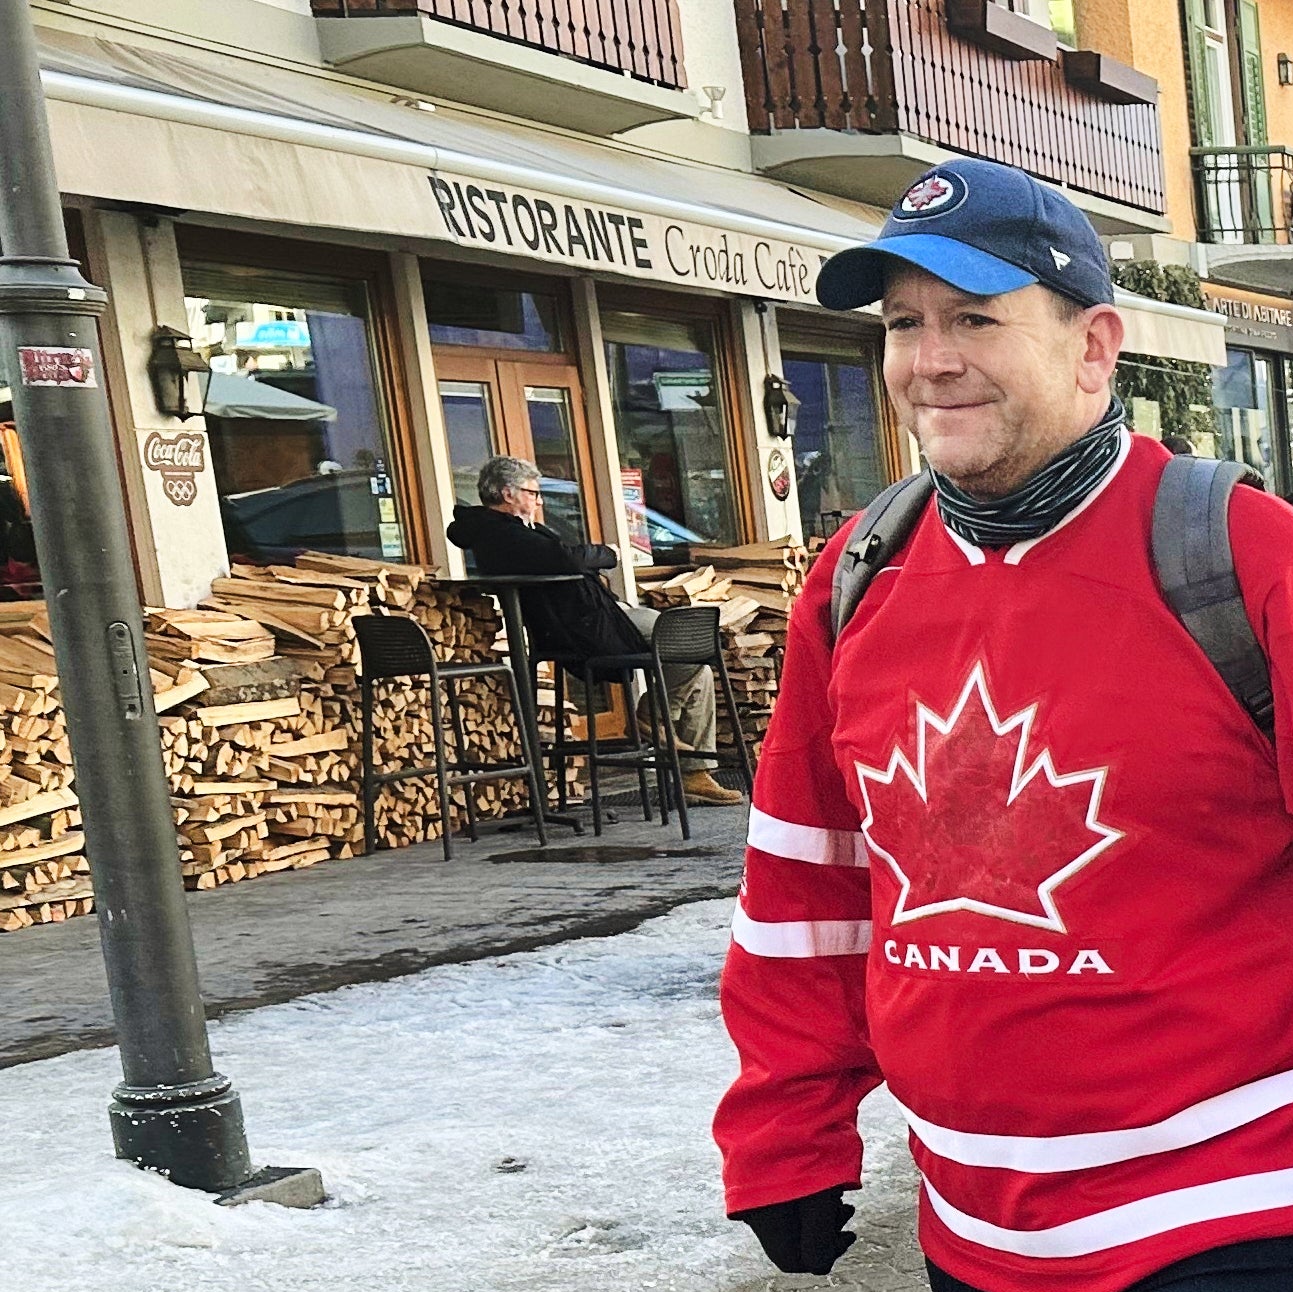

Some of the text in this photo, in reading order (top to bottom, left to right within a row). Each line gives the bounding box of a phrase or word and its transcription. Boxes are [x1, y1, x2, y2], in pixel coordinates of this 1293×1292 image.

[427, 176, 811, 297] RISTORANTE Croda Cafè
[884, 939, 1115, 976] CANADA
